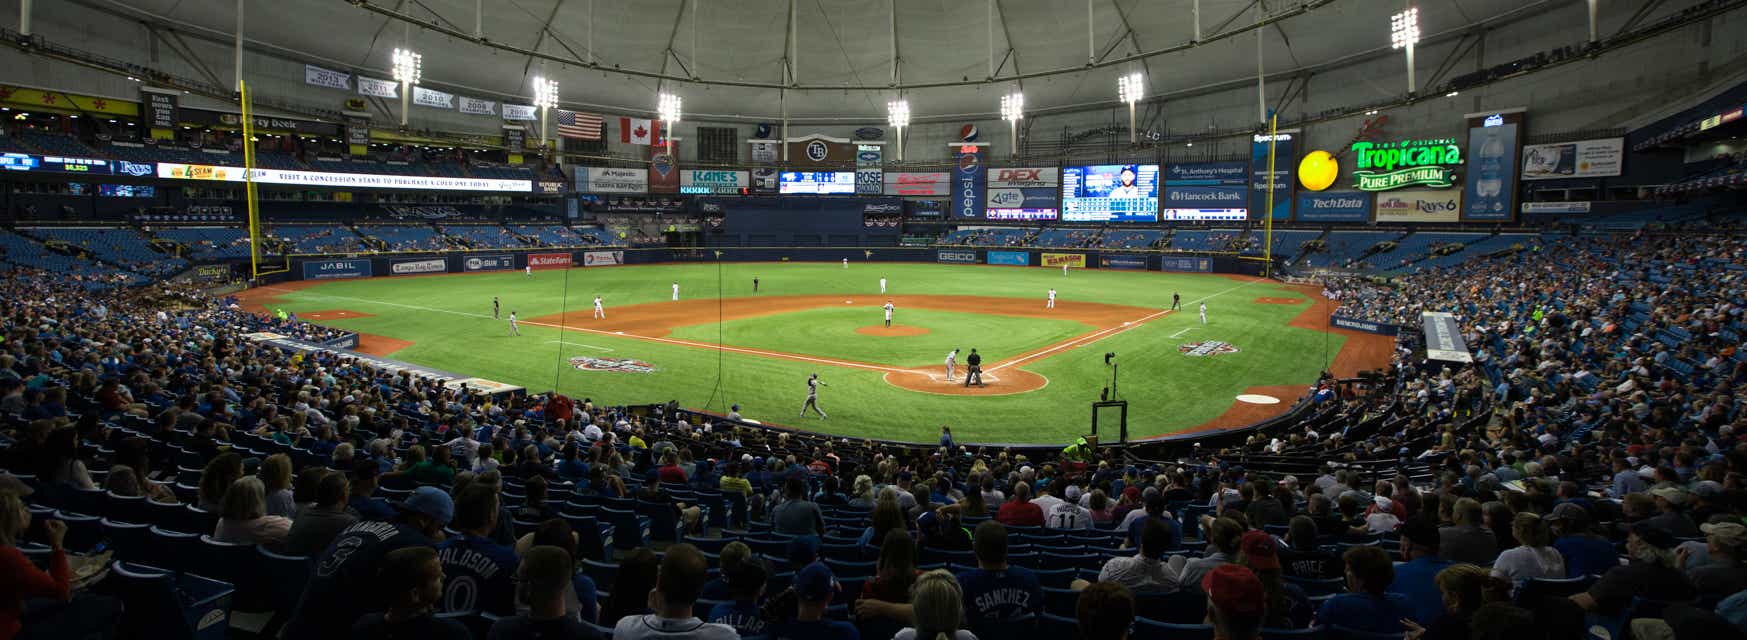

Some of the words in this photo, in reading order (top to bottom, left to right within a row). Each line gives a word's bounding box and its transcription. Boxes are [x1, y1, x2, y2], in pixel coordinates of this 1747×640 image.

[1352, 140, 1460, 170] Tropicana
[279, 173, 301, 181] VISIT
[310, 175, 356, 184] CONCESSION
[394, 178, 428, 186] PURCHASE
[857, 172, 882, 183] ROSE
[998, 169, 1043, 182] DEX
[1360, 175, 1389, 188] PURE
[1390, 169, 1444, 186] PREMIUM
[961, 175, 976, 217] pepsi
[1180, 192, 1217, 201] Hancock
[1218, 192, 1241, 201] Bank
[939, 252, 975, 261] GEICO
[320, 262, 356, 270] JABIL
[975, 587, 1031, 613] SANCHEZ
